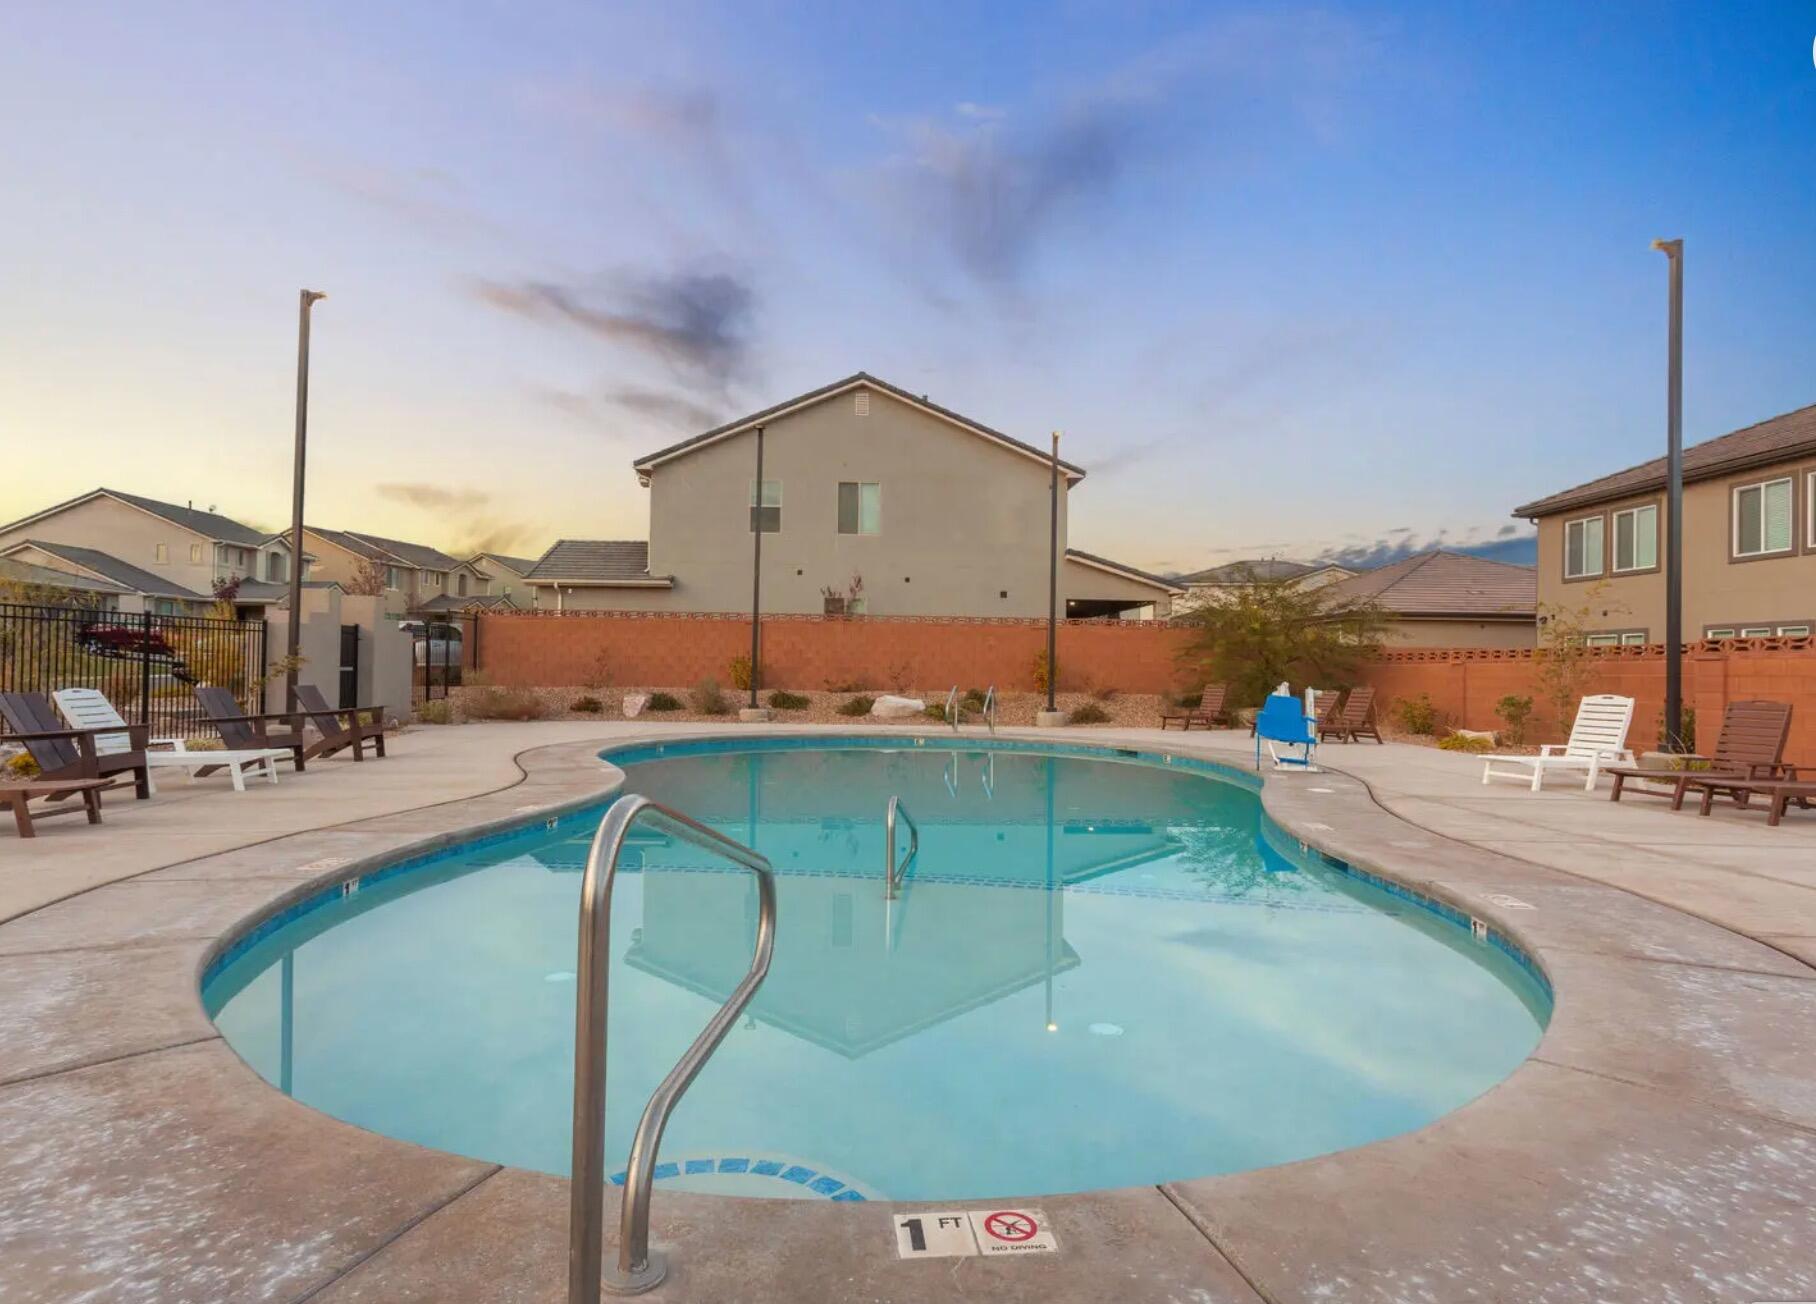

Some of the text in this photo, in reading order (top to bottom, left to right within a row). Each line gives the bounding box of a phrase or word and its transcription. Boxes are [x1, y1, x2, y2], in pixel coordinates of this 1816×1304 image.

[900, 1217, 962, 1251] 1 FT
[991, 1243, 1048, 1252] NO DIVING
